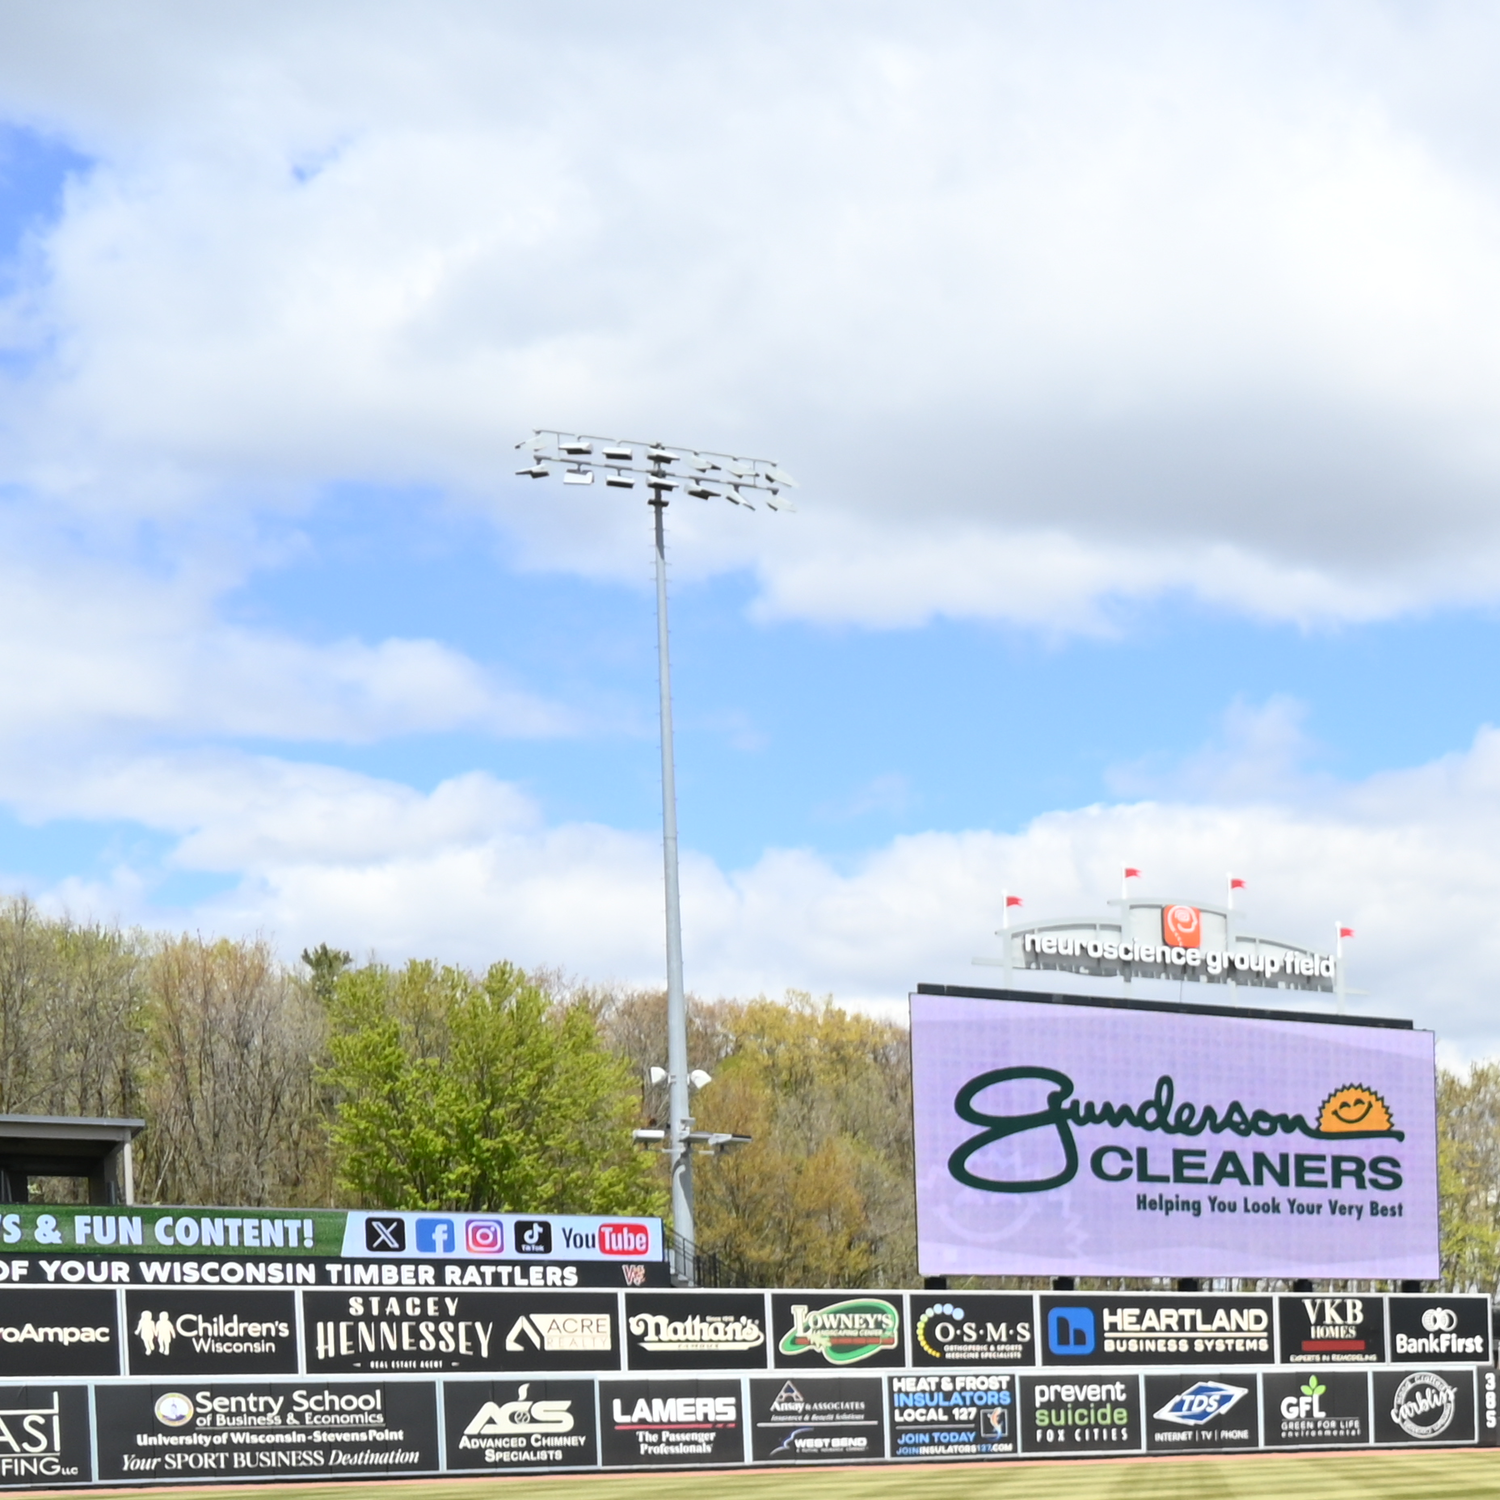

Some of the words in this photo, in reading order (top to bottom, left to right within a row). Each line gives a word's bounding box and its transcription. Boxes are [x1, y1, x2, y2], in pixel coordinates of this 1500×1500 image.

[1024, 934, 1201, 966] neuroscience
[1206, 951, 1280, 978] group
[1284, 952, 1336, 978] field
[948, 1066, 1405, 1193] Gunderson
[1090, 1145, 1404, 1191] CLEANERS
[1136, 1194, 1202, 1217] Helping
[1209, 1196, 1238, 1214] You
[1243, 1197, 1281, 1215] Look
[1287, 1198, 1323, 1216] Your
[1328, 1200, 1364, 1220] Very
[1370, 1201, 1404, 1218] Best
[34, 1214, 62, 1245] &
[75, 1215, 143, 1246] FUN
[154, 1216, 314, 1248] CONTENT!
[39, 1260, 130, 1282] YOUR
[139, 1261, 316, 1284] WISCONSIN
[326, 1263, 435, 1285] TIMBER
[445, 1265, 578, 1286] RATTLERS
[349, 1296, 459, 1317] STACEY
[1302, 1299, 1364, 1325] VKB
[176, 1314, 290, 1338] Children's
[547, 1318, 607, 1334] ACRE
[791, 1305, 895, 1338] LOWNEY'S
[1103, 1308, 1269, 1331] HEARTLAND
[629, 1313, 764, 1345] Nathan's
[1311, 1326, 1357, 1339] HOMES
[192, 1338, 276, 1353] Wisconsin
[316, 1321, 493, 1360] HENNESSEY
[547, 1336, 607, 1349] REALTY
[997, 1344, 1023, 1352] SPORTS
[1104, 1340, 1190, 1352] BUSINESS
[1193, 1339, 1269, 1352] SYSTEMS
[981, 1352, 1022, 1360] SPECIALISTS
[893, 1377, 939, 1392] HEAT
[941, 1377, 953, 1391] &
[956, 1376, 1010, 1391] FROST
[196, 1391, 284, 1416] Sentry
[292, 1389, 382, 1412] School
[894, 1391, 1011, 1407] INSULATORS
[1035, 1382, 1126, 1408] prevent
[612, 1397, 736, 1422] LAMERS
[813, 1401, 865, 1411] ASSOCIATES
[1181, 1395, 1221, 1412] TDS
[1281, 1394, 1326, 1420] GFL
[196, 1414, 213, 1427] of
[216, 1413, 282, 1427] Business
[286, 1413, 300, 1425] &
[305, 1411, 385, 1425] Economics
[463, 1400, 575, 1435] ACS
[895, 1408, 948, 1422] LOCAL
[952, 1407, 977, 1420] 127
[1035, 1404, 1128, 1426] suicide
[1281, 1420, 1314, 1431] GREEN
[1317, 1420, 1337, 1430] FOR
[1340, 1419, 1360, 1429] LIFE
[1281, 1428, 1361, 1438] environmental
[136, 1432, 211, 1447] University
[213, 1431, 228, 1444] of
[368, 1428, 404, 1442] Point
[459, 1434, 527, 1450] ADVANCED
[530, 1434, 586, 1448] CHIMNEY
[637, 1431, 658, 1443] The
[661, 1431, 716, 1444] Passenger
[795, 1438, 830, 1448] WEST
[831, 1437, 867, 1448] BEND
[897, 1433, 930, 1444] JOIN
[932, 1432, 976, 1443] TODAY
[1036, 1429, 1065, 1442] FOX
[1074, 1428, 1128, 1442] CITIES
[1155, 1431, 1193, 1442] INTERNET
[1200, 1431, 1212, 1441] TV
[1220, 1430, 1249, 1440] PHONE
[485, 1449, 562, 1462] SPECIALISTS
[640, 1443, 713, 1455] Professionals
[122, 1455, 162, 1471] Your
[164, 1452, 229, 1470] SPORT
[233, 1450, 325, 1469] BUSINESS
[329, 1449, 420, 1466] Destination
